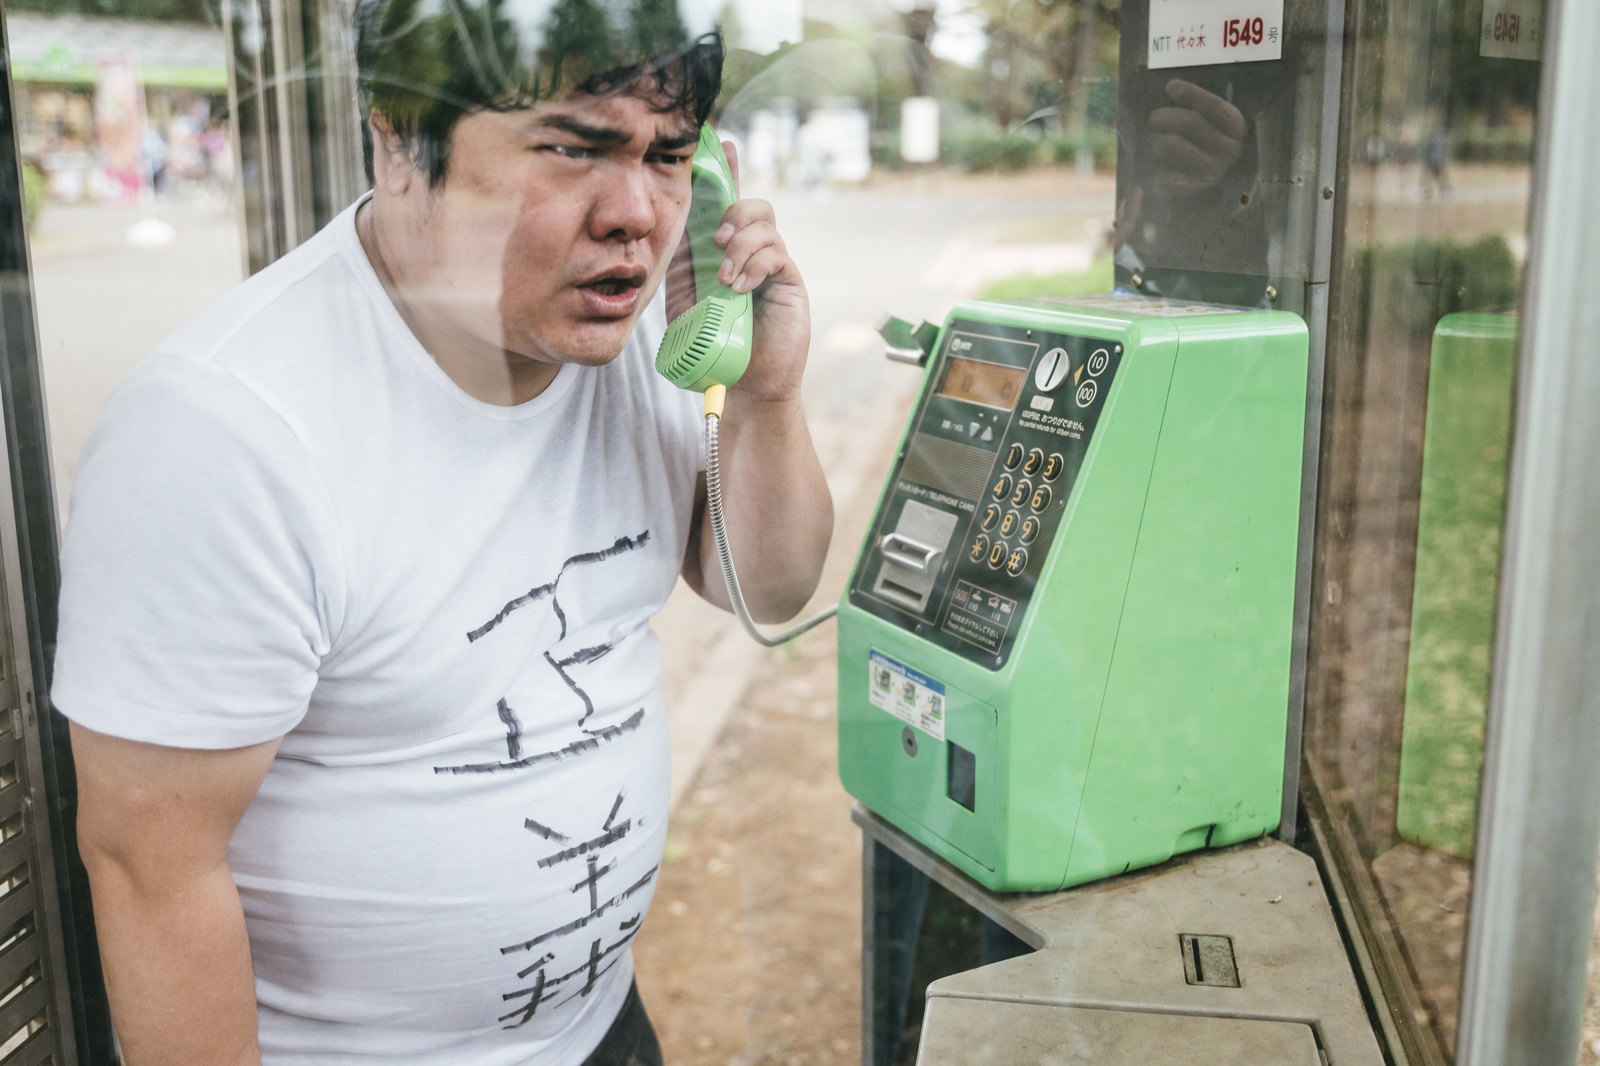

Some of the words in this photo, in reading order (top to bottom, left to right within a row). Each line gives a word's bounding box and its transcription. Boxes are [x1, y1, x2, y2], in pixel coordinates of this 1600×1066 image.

[1152, 36, 1172, 53] NTT
[1176, 33, 1207, 50] 代々木
[1222, 16, 1264, 49] 1549
[1267, 26, 1280, 44] 号
[1091, 355, 1104, 370] 10
[1078, 386, 1094, 401] 100
[1006, 447, 1015, 465] 1
[1023, 452, 1036, 471] 2
[1043, 457, 1055, 476] 3
[993, 478, 1005, 496] 4
[1012, 483, 1025, 502] 5
[1031, 489, 1044, 508] 6
[983, 508, 995, 527] 7
[1000, 514, 1013, 533] 8
[1021, 520, 1033, 539] 9
[989, 544, 1002, 563] 0
[1007, 551, 1021, 570] #
[433, 528, 659, 1030] 正義
